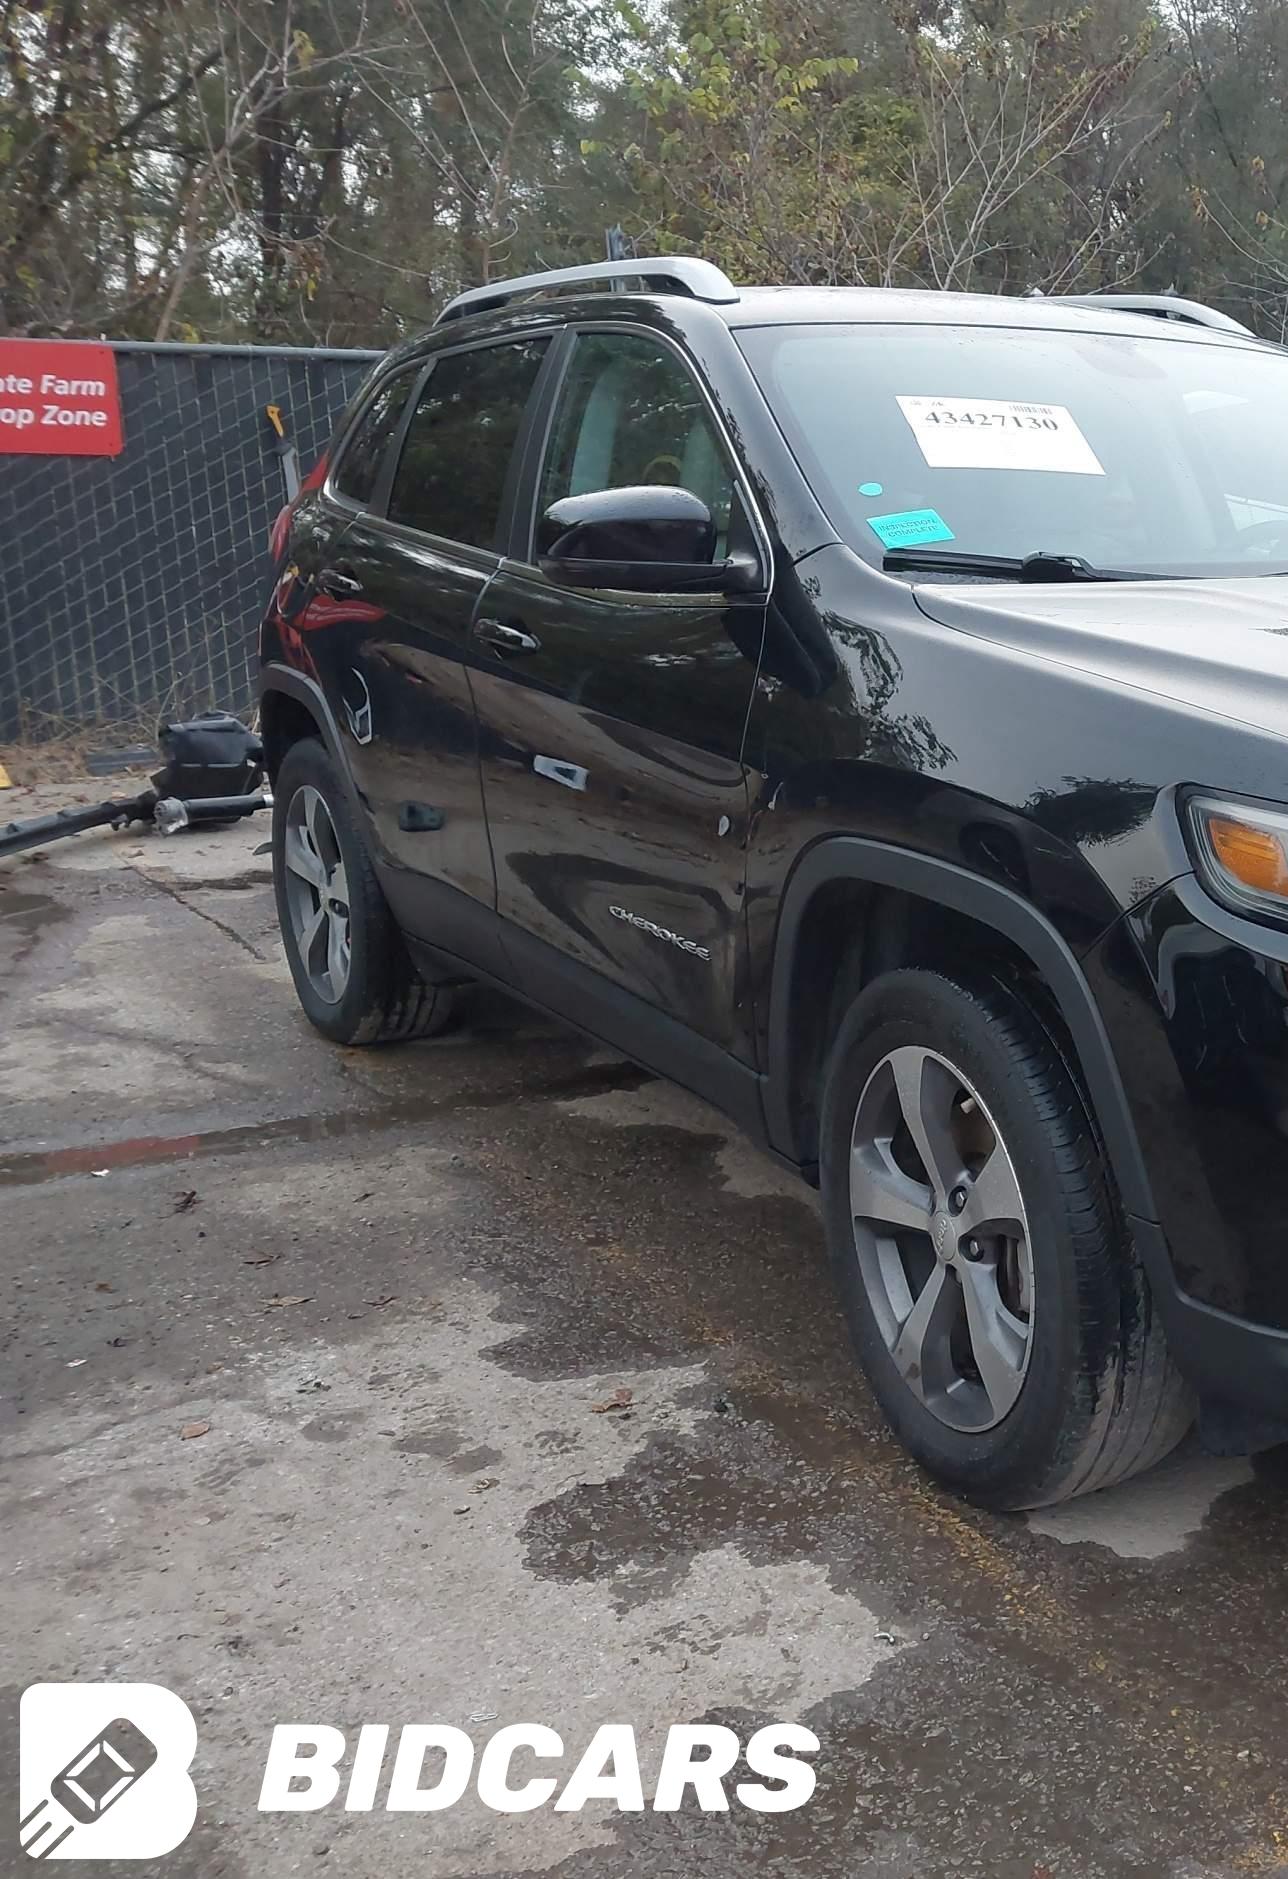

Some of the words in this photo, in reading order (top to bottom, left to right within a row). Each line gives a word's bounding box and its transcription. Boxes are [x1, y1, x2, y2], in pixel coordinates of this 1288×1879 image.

[40, 374, 106, 397] Farm
[40, 404, 108, 427] Zone
[925, 411, 1059, 431] 43427130
[609, 905, 712, 961] CHEROKEE
